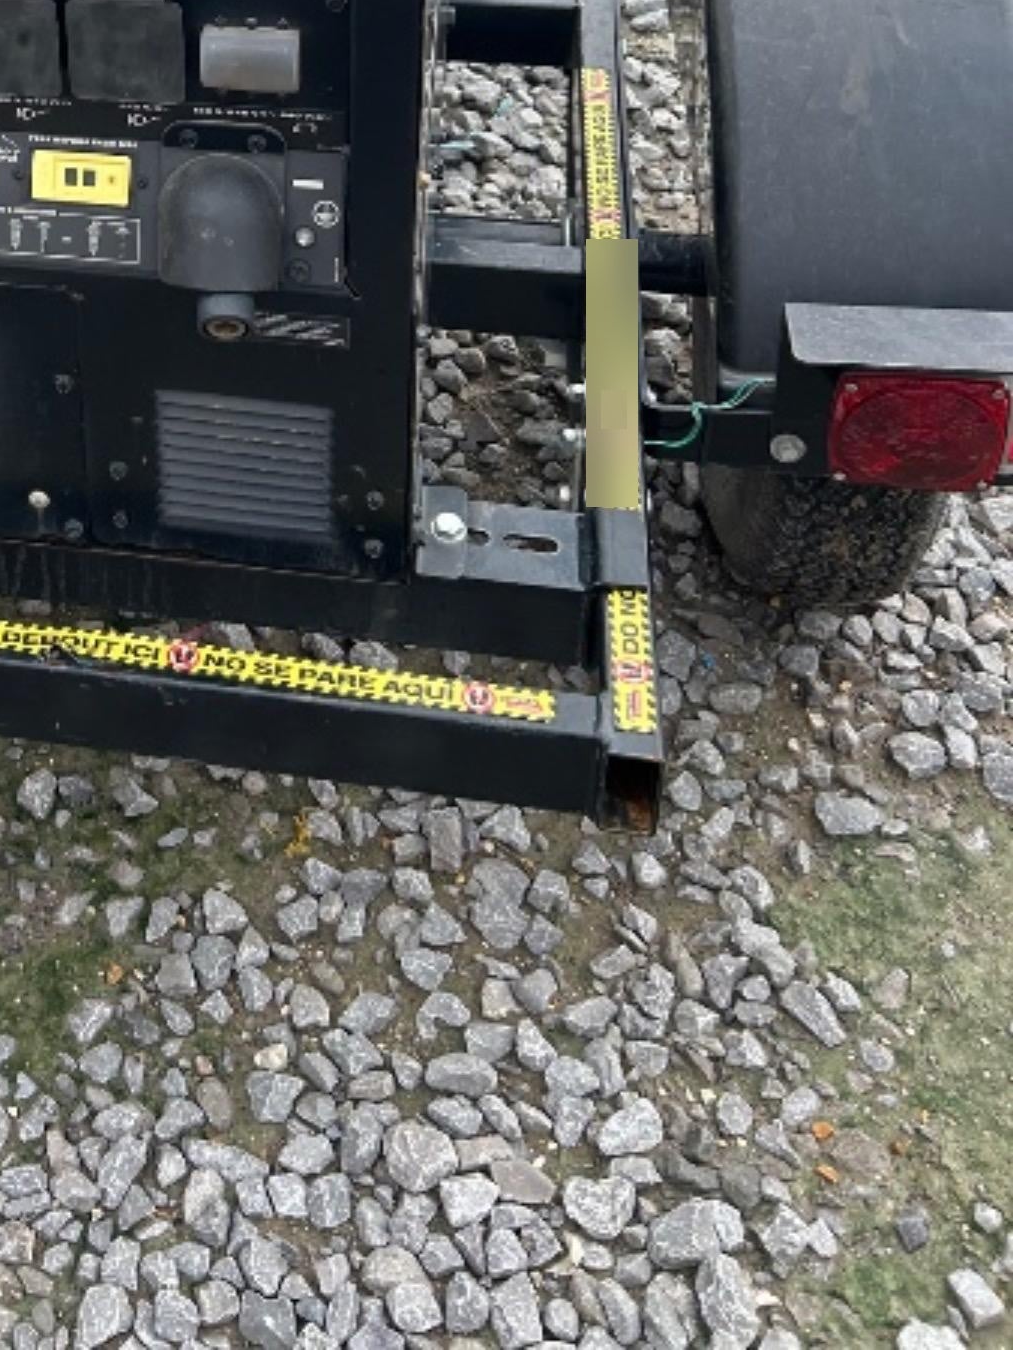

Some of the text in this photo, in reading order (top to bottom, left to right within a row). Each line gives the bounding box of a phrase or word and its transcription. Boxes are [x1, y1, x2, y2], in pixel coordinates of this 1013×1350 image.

[122, 640, 162, 662] ICI
[620, 620, 639, 655] DO
[202, 651, 247, 672] NO
[252, 659, 292, 678] SE
[298, 665, 377, 690] PARE
